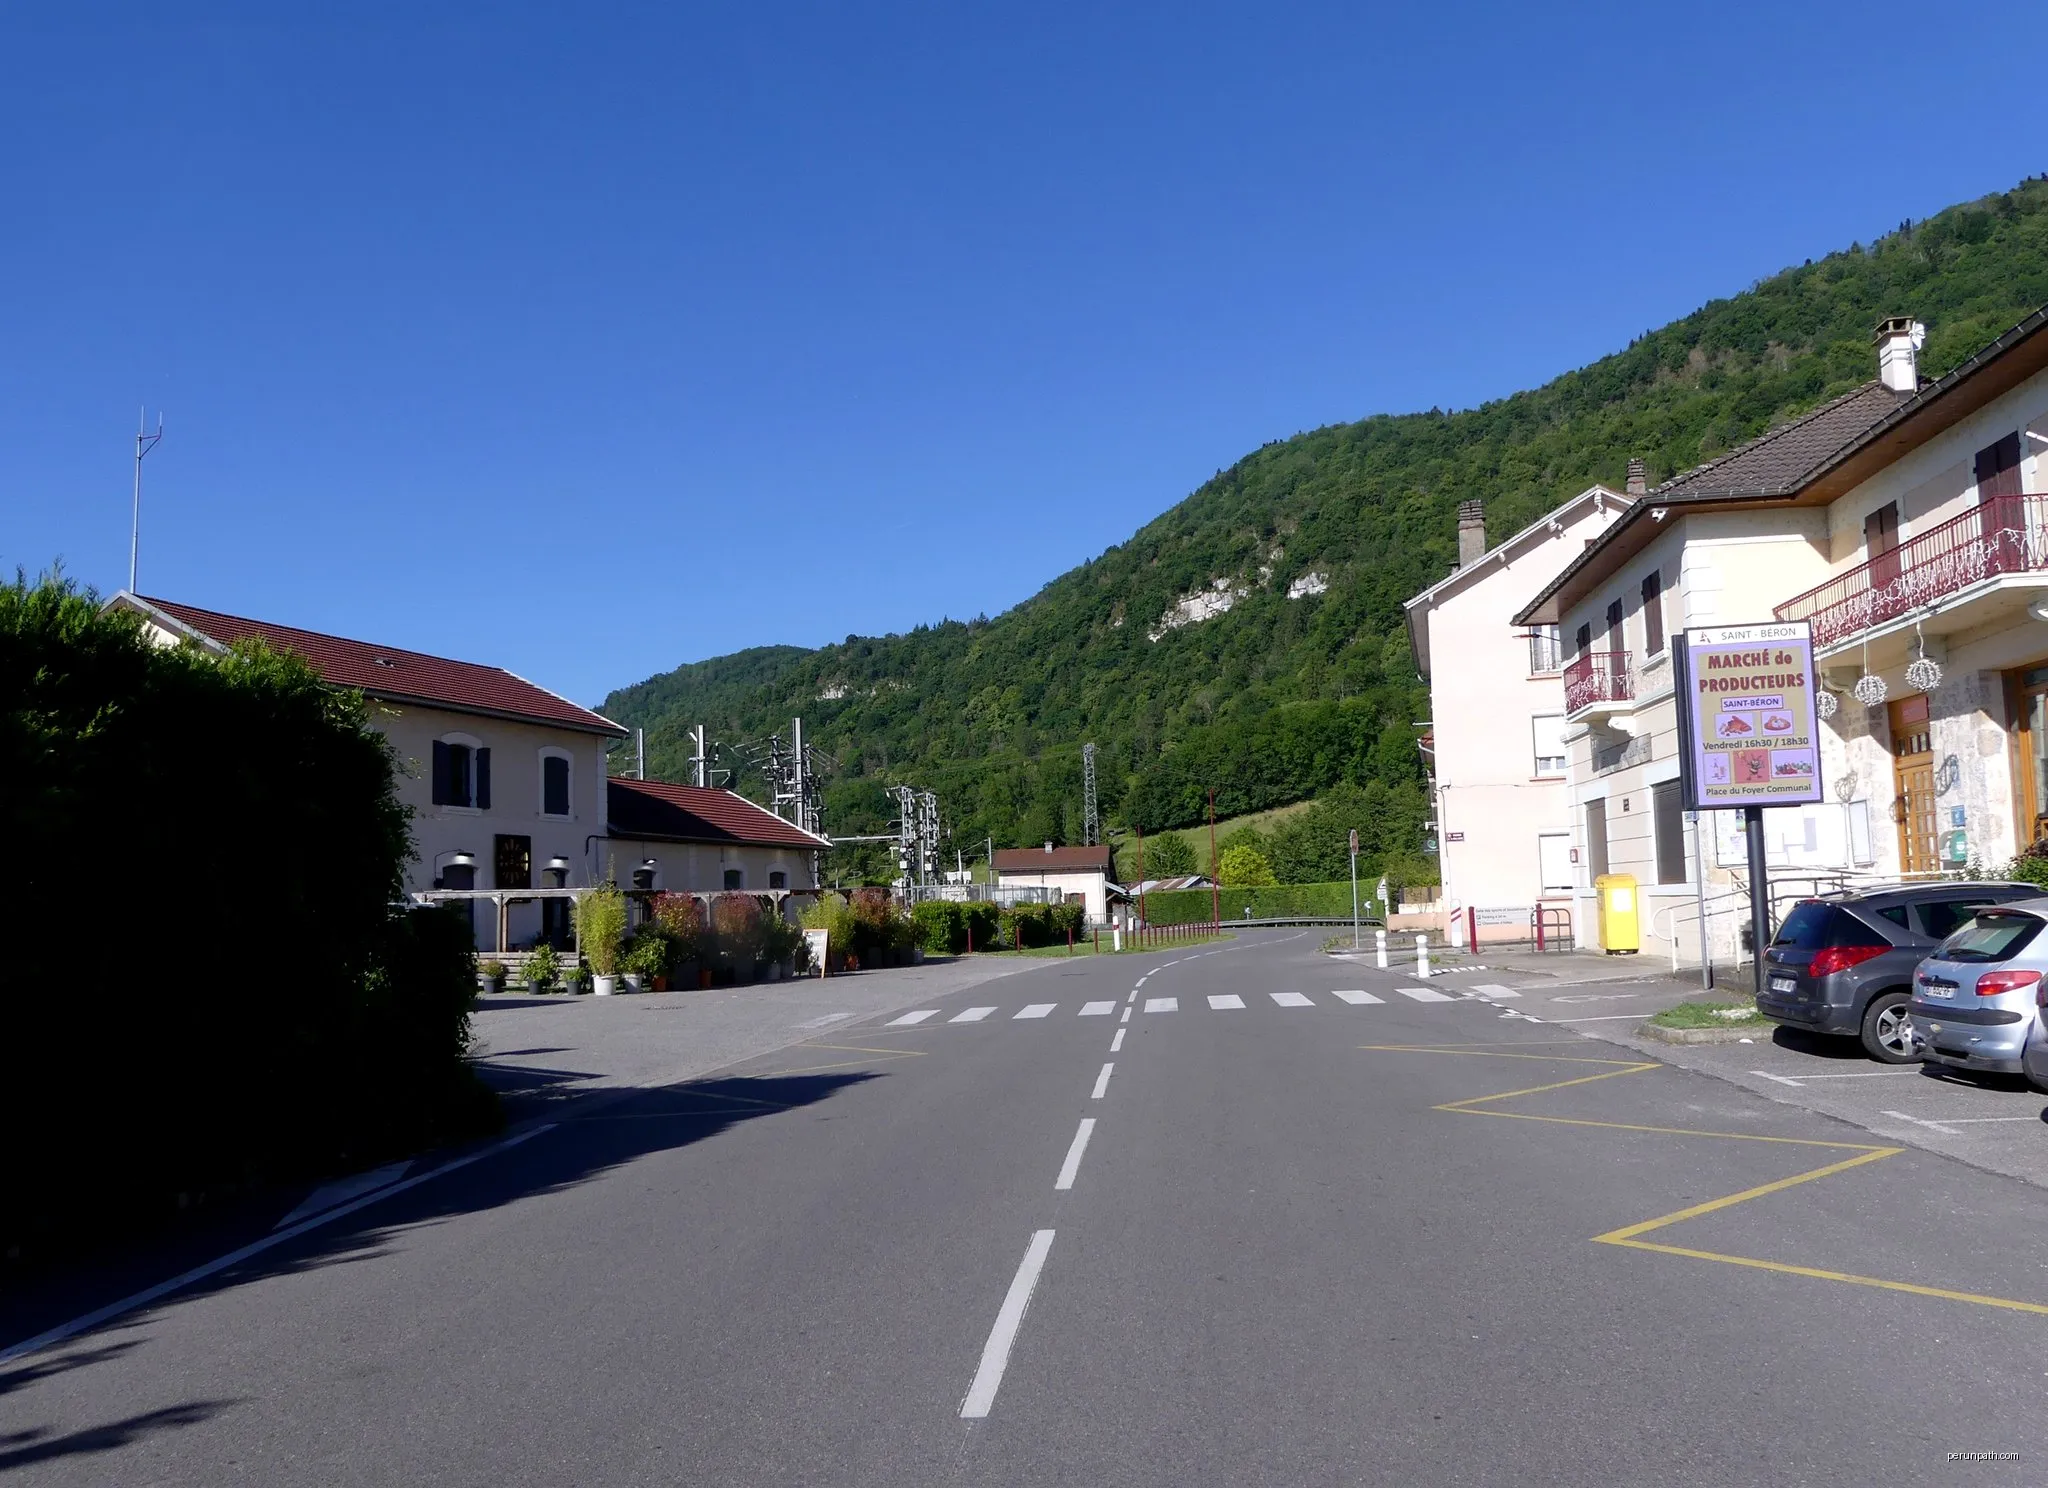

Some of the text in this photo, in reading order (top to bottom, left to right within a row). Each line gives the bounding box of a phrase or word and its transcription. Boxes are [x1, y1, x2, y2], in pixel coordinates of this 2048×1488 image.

[1721, 630, 1752, 640] SAINT
[1761, 628, 1796, 638] BÉRON
[1708, 649, 1792, 669] MARCHÉ de
[1699, 673, 1805, 692] PRODUCTEURS
[1723, 698, 1779, 708] SAINT-BÉRON
[1702, 740, 1743, 750] Vendredi
[1744, 739, 1772, 748] 16h30
[1782, 737, 1809, 746] 18h30
[1706, 784, 1812, 796] Place du Foyer Communal
